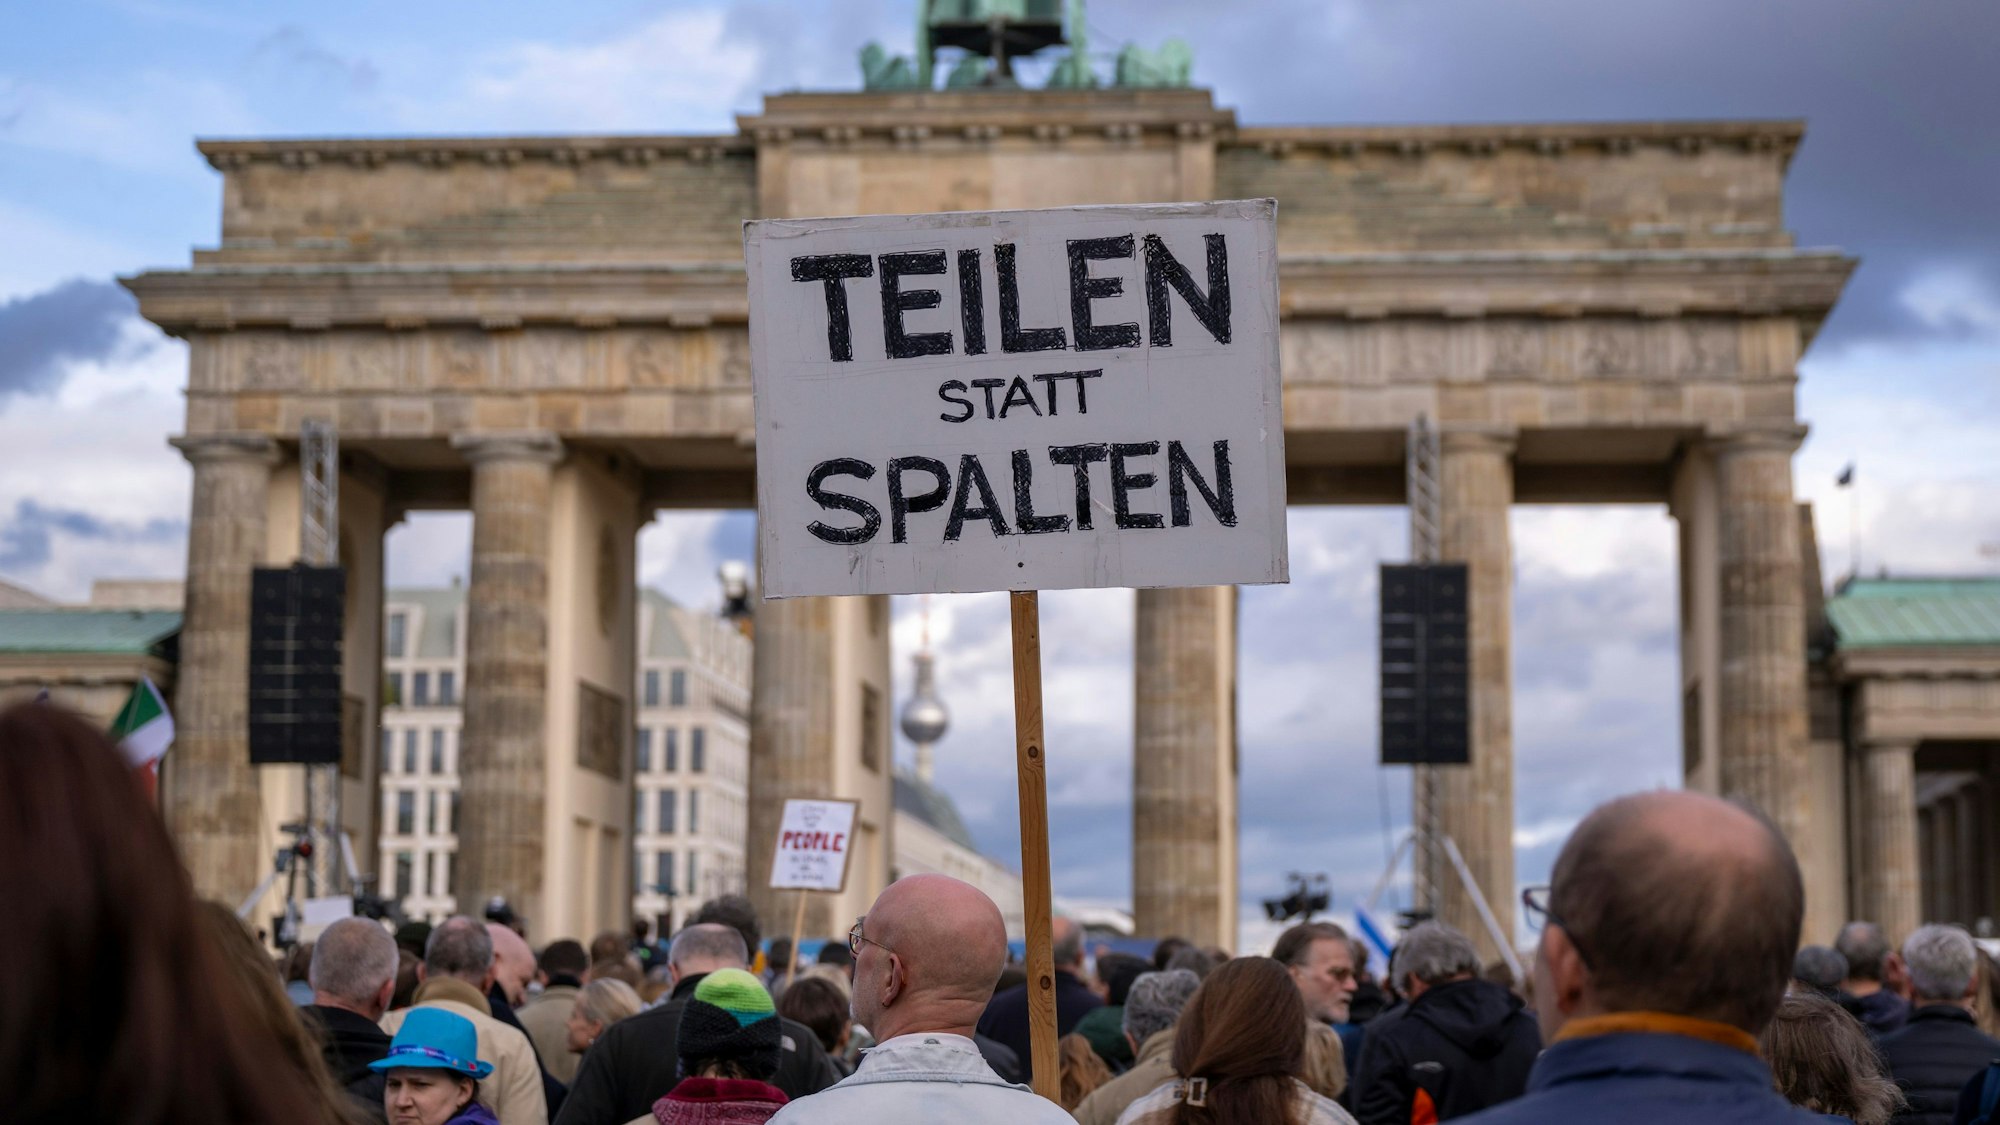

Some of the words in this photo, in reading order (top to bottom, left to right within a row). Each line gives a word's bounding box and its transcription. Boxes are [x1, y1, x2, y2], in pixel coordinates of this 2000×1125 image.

[790, 232, 1232, 362] TEILEN
[938, 368, 1103, 423] STATT
[806, 439, 1238, 545] SPALTEN
[781, 830, 845, 853] PEOPLE
